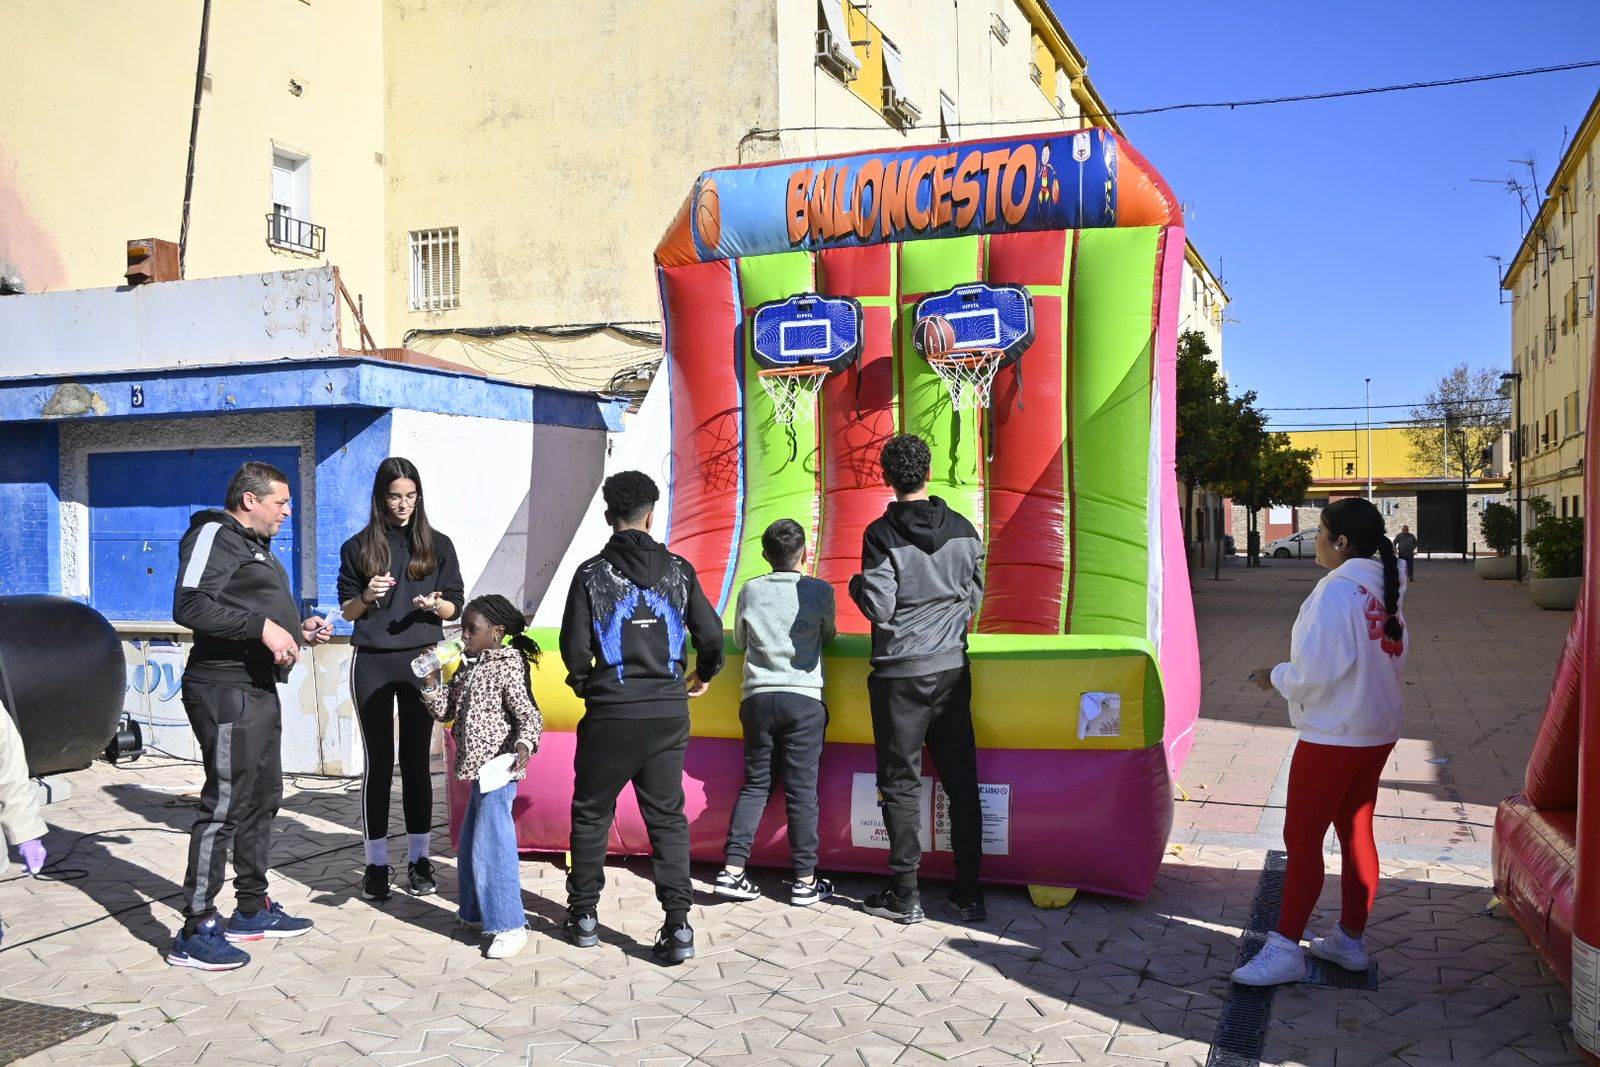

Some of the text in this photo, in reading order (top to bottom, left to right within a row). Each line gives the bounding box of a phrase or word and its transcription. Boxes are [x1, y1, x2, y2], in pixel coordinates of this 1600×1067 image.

[786, 144, 1037, 247] BALONCESTO
[133, 384, 143, 406] 3
[985, 786, 1000, 794] USO
